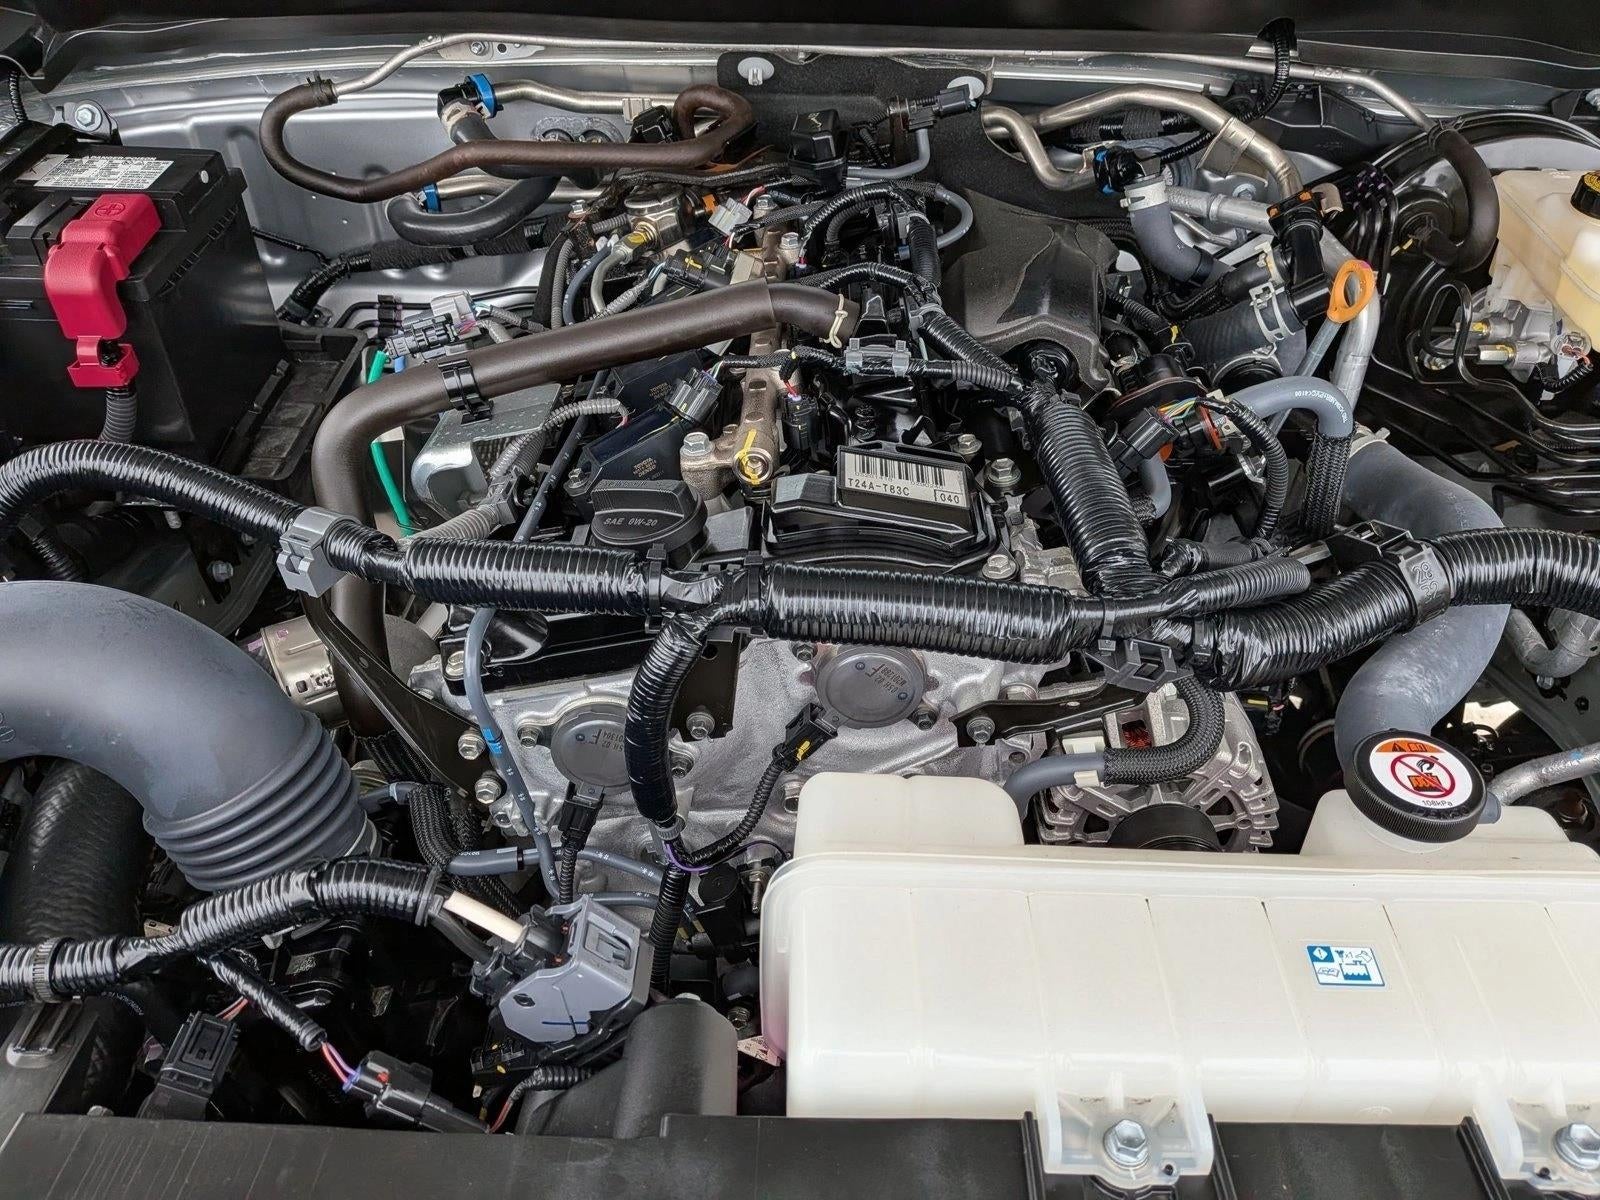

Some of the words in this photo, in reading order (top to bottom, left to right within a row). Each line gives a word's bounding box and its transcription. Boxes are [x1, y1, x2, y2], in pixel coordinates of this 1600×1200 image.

[848, 478, 910, 496] T24A-T83C
[940, 493, 960, 503] 040
[603, 517, 625, 525] SAE
[628, 518, 658, 527] 0W-20
[1411, 561, 1434, 586] 28
[1422, 799, 1453, 807] 108kPa
